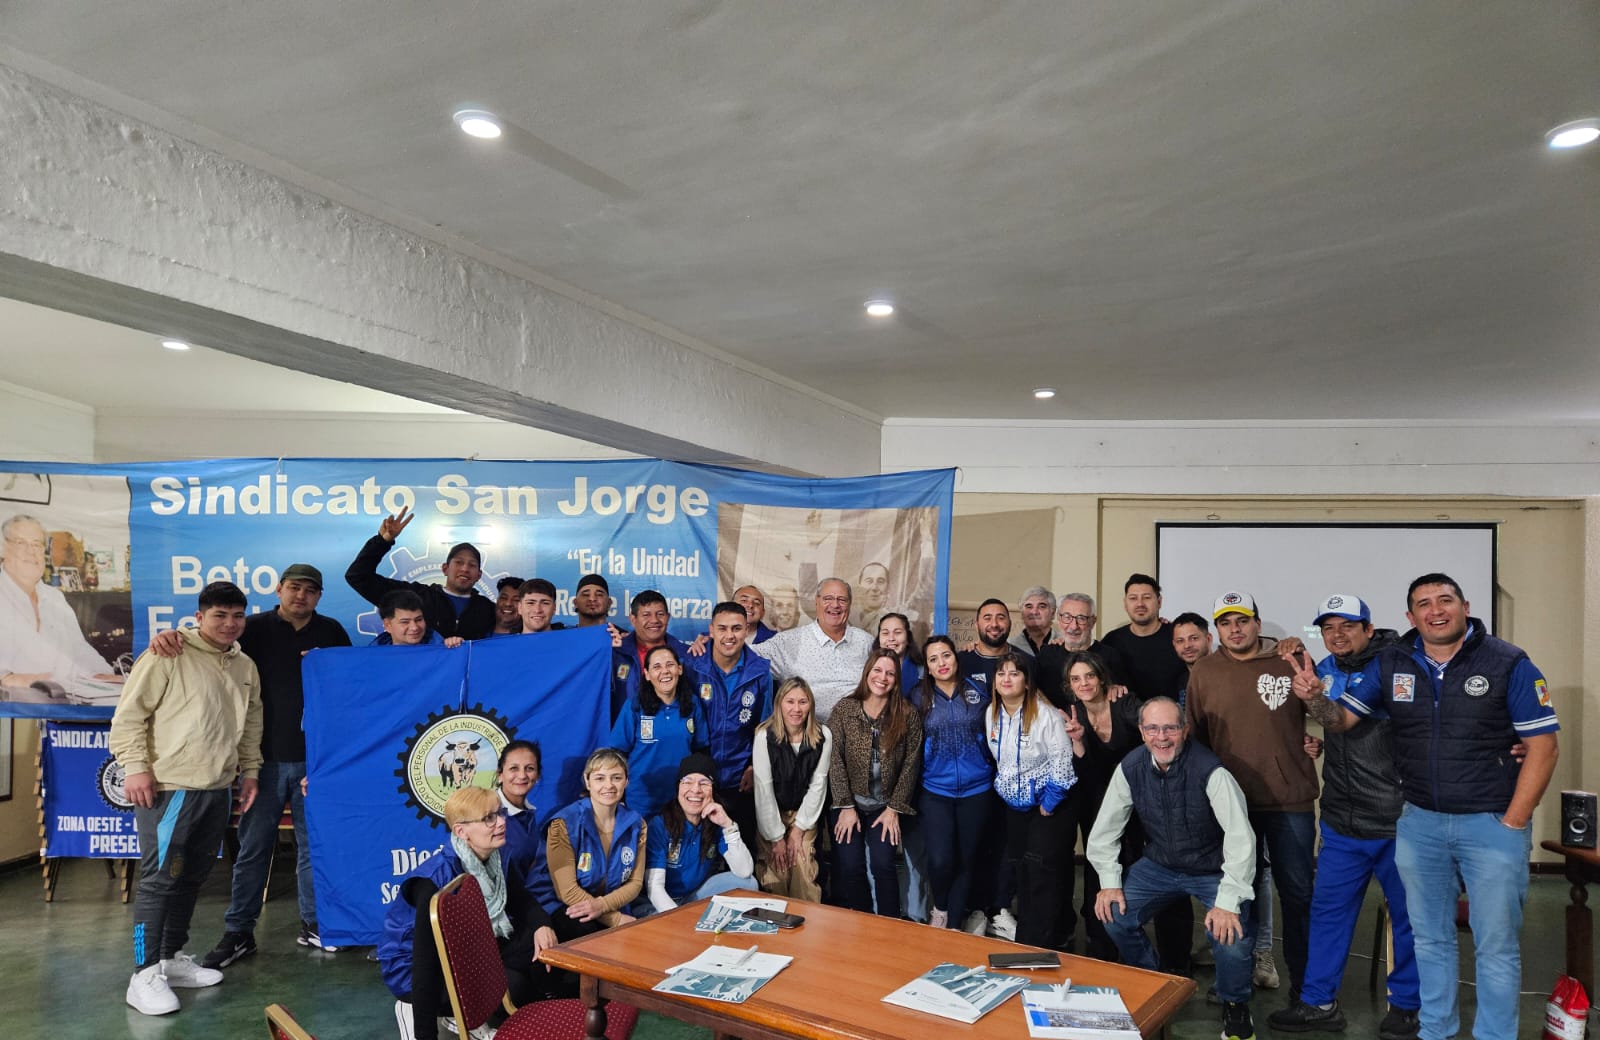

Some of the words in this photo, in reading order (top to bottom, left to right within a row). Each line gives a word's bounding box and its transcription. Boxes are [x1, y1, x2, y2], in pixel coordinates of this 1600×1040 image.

[150, 475, 415, 516] Sindicato
[435, 474, 538, 515] San
[557, 477, 709, 524] Jorge
[171, 556, 279, 595] Beto
[609, 548, 625, 575] la
[632, 548, 699, 577] Unidad
[50, 730, 110, 748] SINDICAT
[414, 733, 439, 770] PERSONAL
[438, 725, 449, 736] DE
[450, 722, 459, 731] LA
[460, 721, 495, 739] INDUSTRIA
[57, 816, 86, 832] ZONA
[87, 816, 122, 832] OESTE
